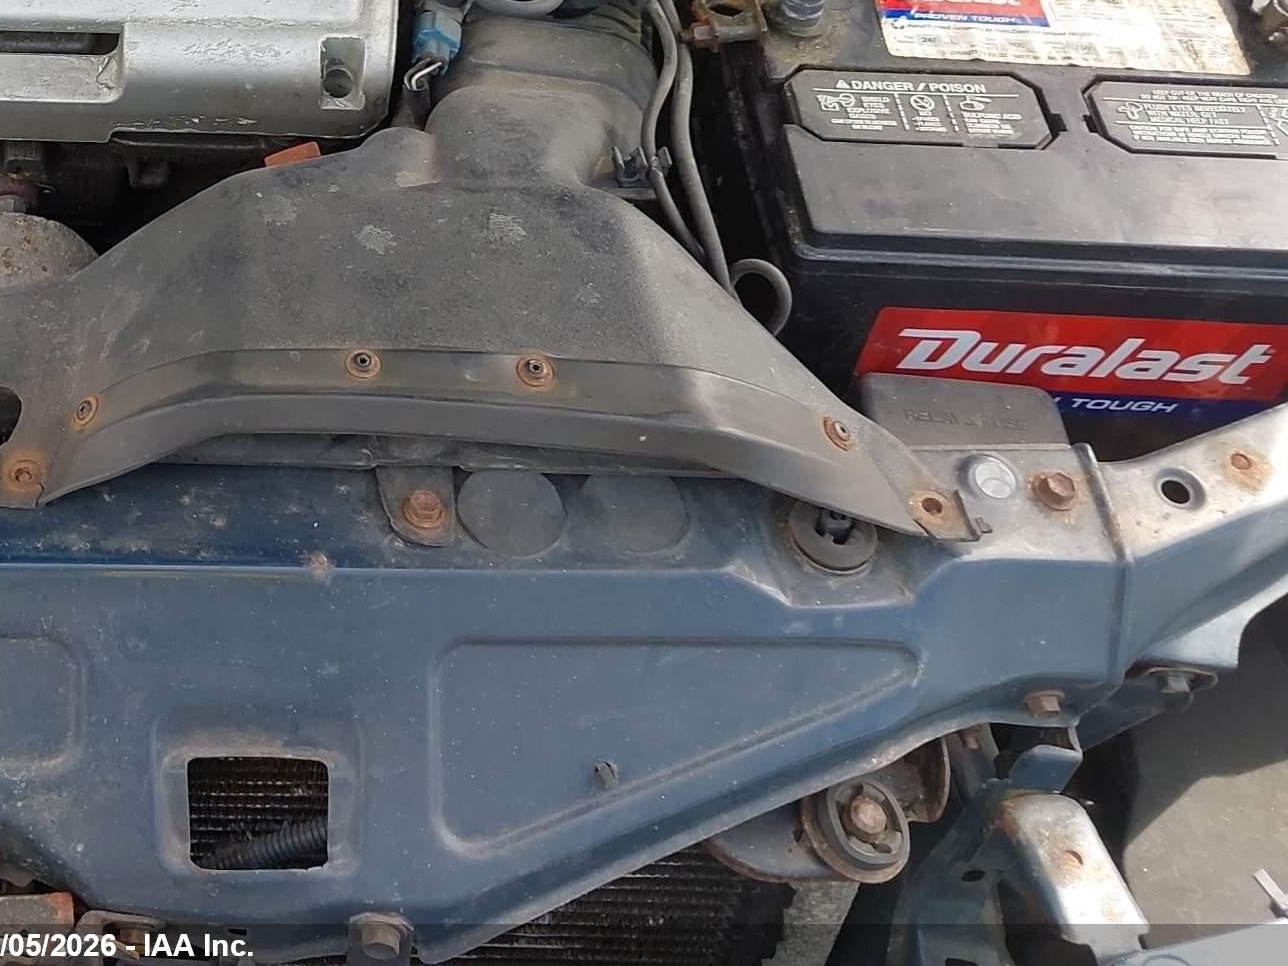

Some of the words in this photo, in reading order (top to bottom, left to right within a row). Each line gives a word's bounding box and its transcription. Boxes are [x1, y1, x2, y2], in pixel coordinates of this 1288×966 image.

[914, 12, 968, 22] PROVEN
[971, 15, 1016, 24] TOUGH
[851, 81, 913, 92] DANGER
[930, 82, 987, 94] POISON
[1143, 103, 1169, 111] FLUSH
[896, 328, 1274, 385] Duralast
[1071, 398, 1178, 413] TOUGH
[904, 408, 959, 426] RELAY
